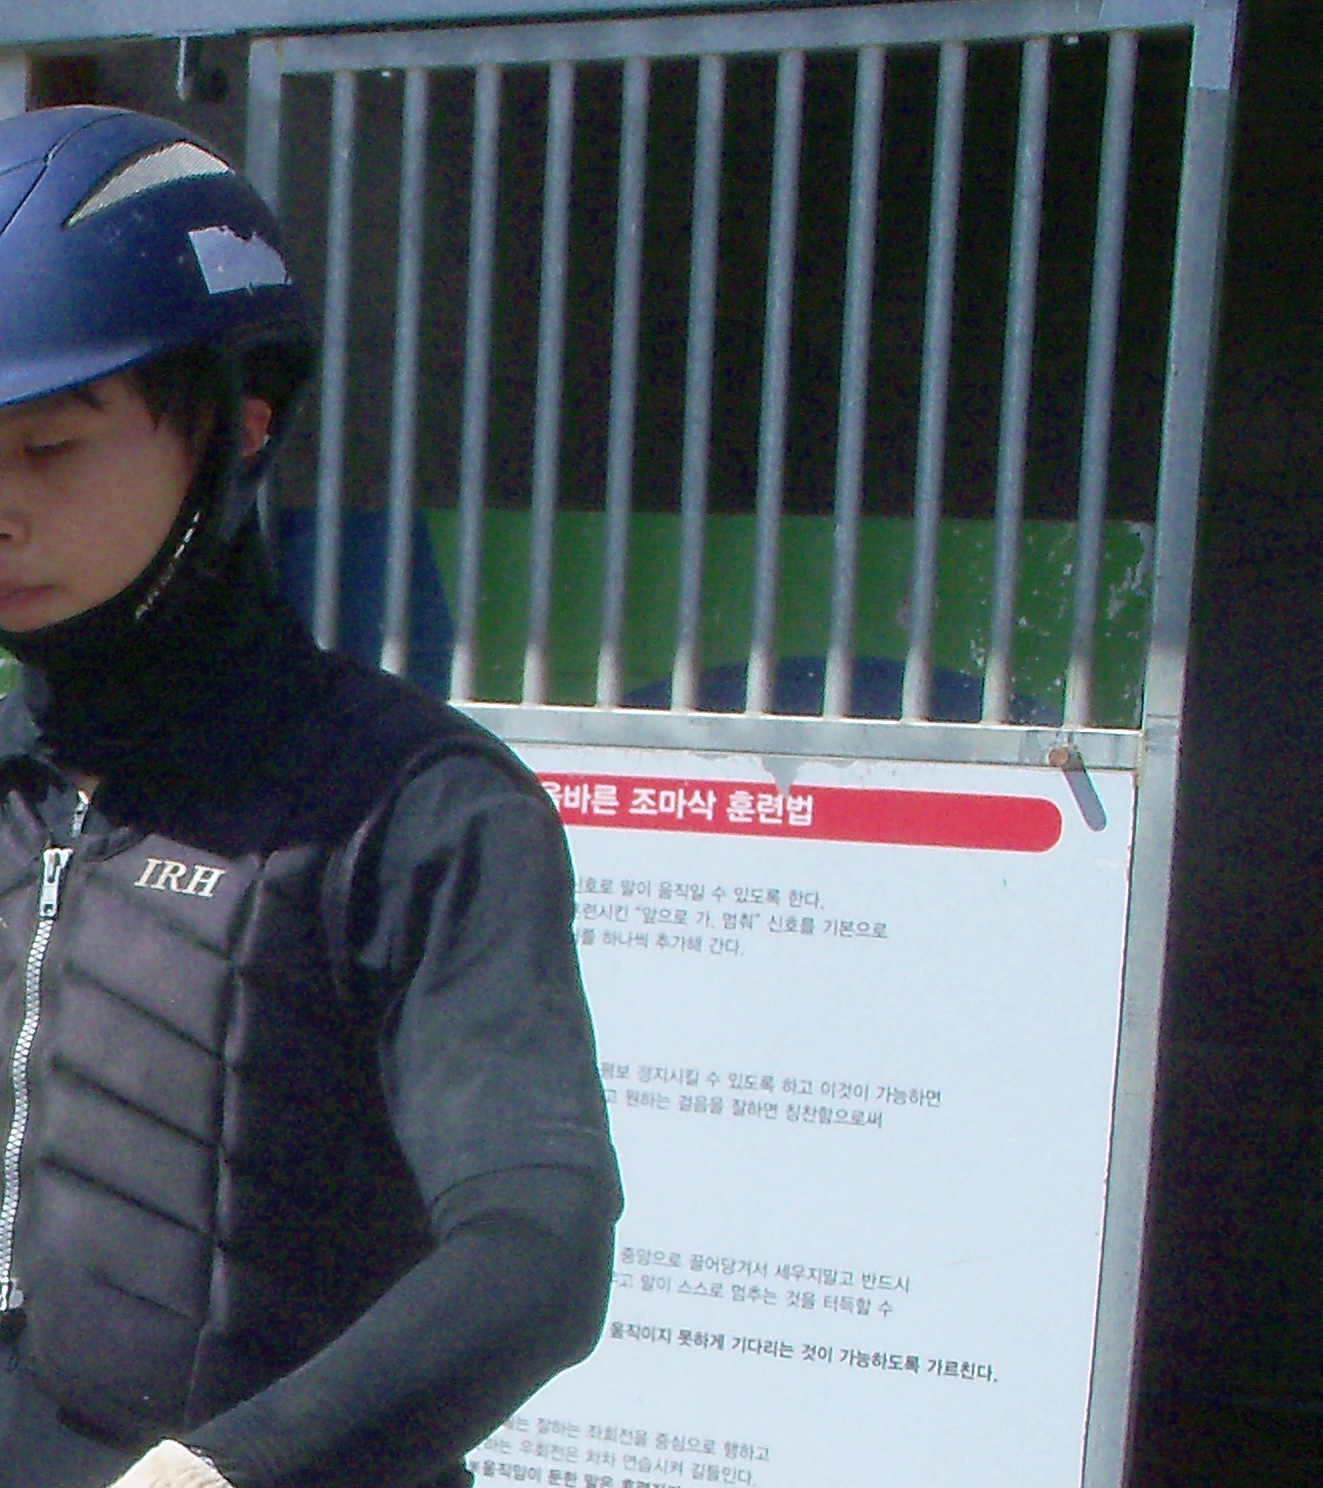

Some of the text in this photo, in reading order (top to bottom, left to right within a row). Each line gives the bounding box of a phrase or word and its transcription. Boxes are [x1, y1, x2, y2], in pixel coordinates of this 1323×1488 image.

[628, 787, 716, 821] 조마삭
[726, 790, 814, 827] 훈련법
[133, 857, 226, 898] IRH
[620, 880, 651, 897] 말이
[658, 881, 705, 901] 움직일
[711, 885, 726, 902] 수
[734, 886, 780, 905] 있도록
[789, 889, 824, 910] 한다.
[577, 903, 629, 922] 련시킨
[768, 915, 814, 935] 신호를
[823, 918, 888, 939] 기본으로
[602, 930, 650, 949] 하나씩
[656, 933, 702, 953] 추가해
[709, 937, 745, 957] 간다.
[638, 1065, 699, 1086] 정지시킬
[706, 1071, 720, 1088] 수
[728, 1072, 776, 1092] 있도록
[782, 1077, 814, 1095] 하고
[820, 1080, 869, 1101] 이것이
[876, 1085, 941, 1107] 가능하면
[679, 1094, 724, 1114] 걸음을
[732, 1098, 778, 1119] 잘하면
[786, 1103, 883, 1129] 칭찬함으로써
[621, 1247, 682, 1268] 중앙으로
[775, 1261, 855, 1287] 세우지말고
[861, 1272, 911, 1294] 반드시
[612, 1271, 894, 1318] 고 말이 스스로 멈추는 것을 터득할 수
[610, 1320, 999, 1383] 움직이지 못하게 기다리는 것이 가능하도록 가르친다.
[655, 1432, 716, 1455] 중심으로
[723, 1441, 770, 1462] 행하고
